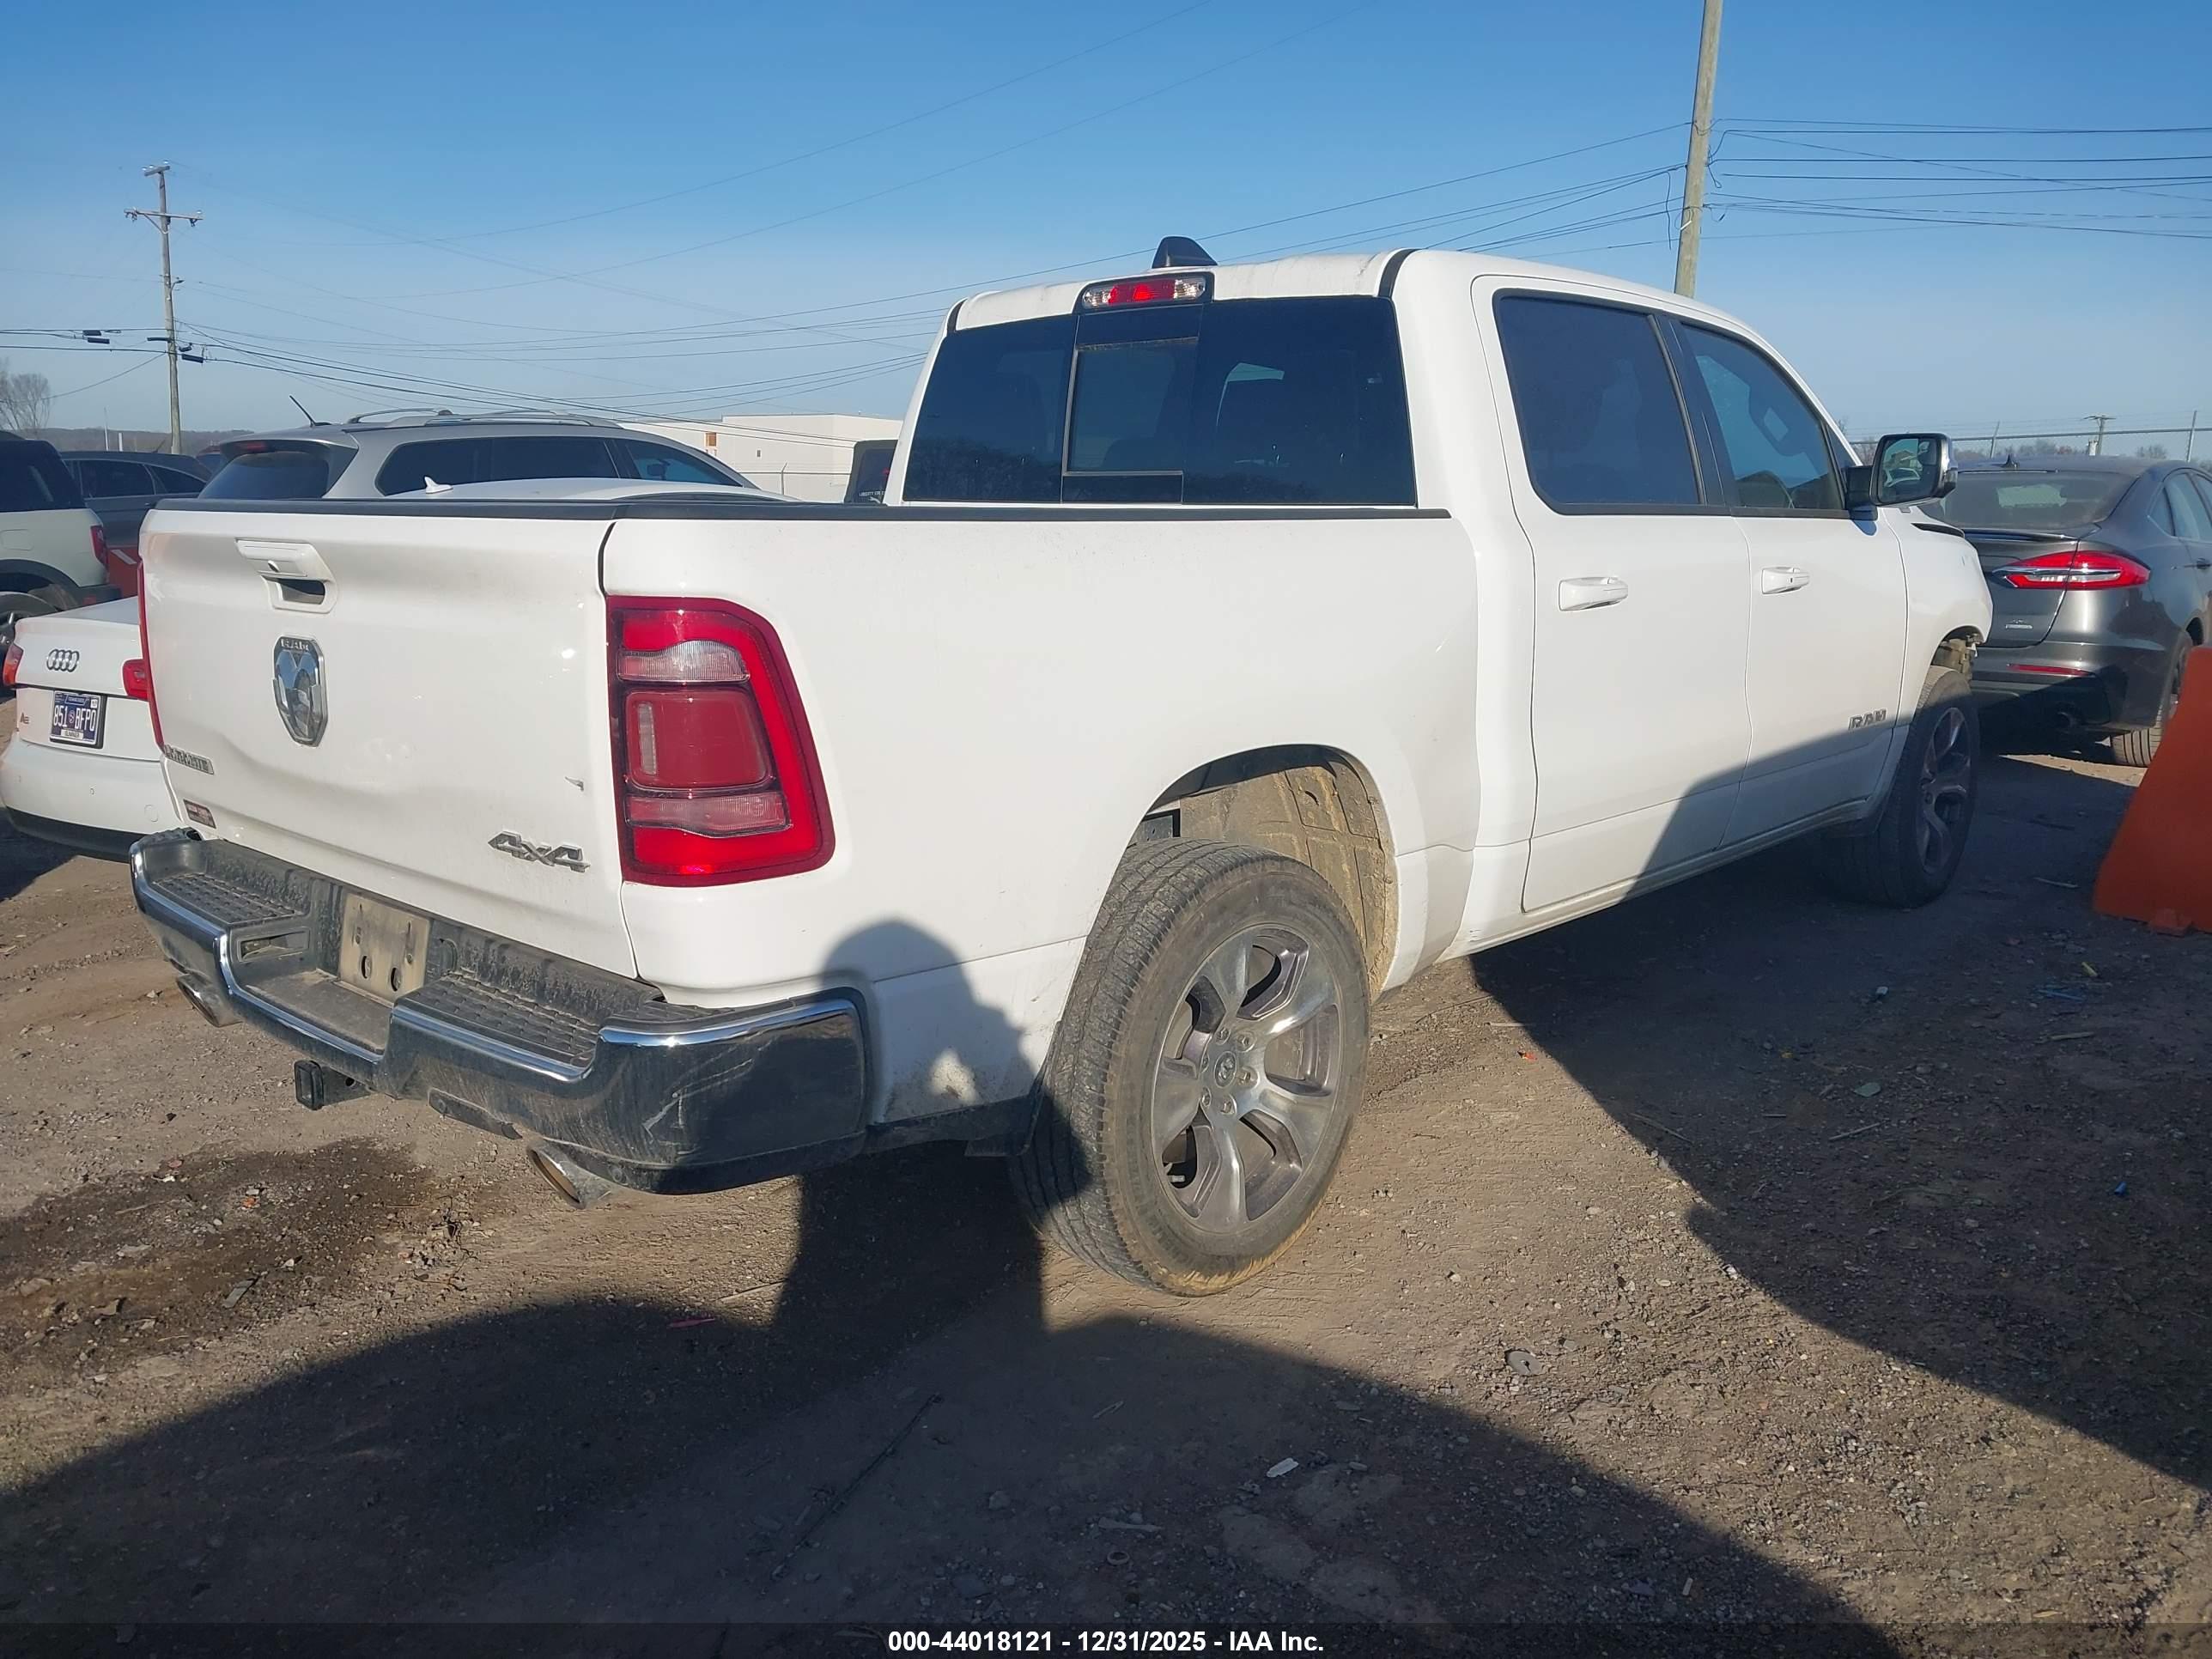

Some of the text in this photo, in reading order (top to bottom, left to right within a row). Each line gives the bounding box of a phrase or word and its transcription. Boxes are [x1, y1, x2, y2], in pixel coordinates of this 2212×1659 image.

[280, 637, 310, 652] RAM
[53, 704, 68, 727] 851
[1847, 708, 1887, 731] RAM
